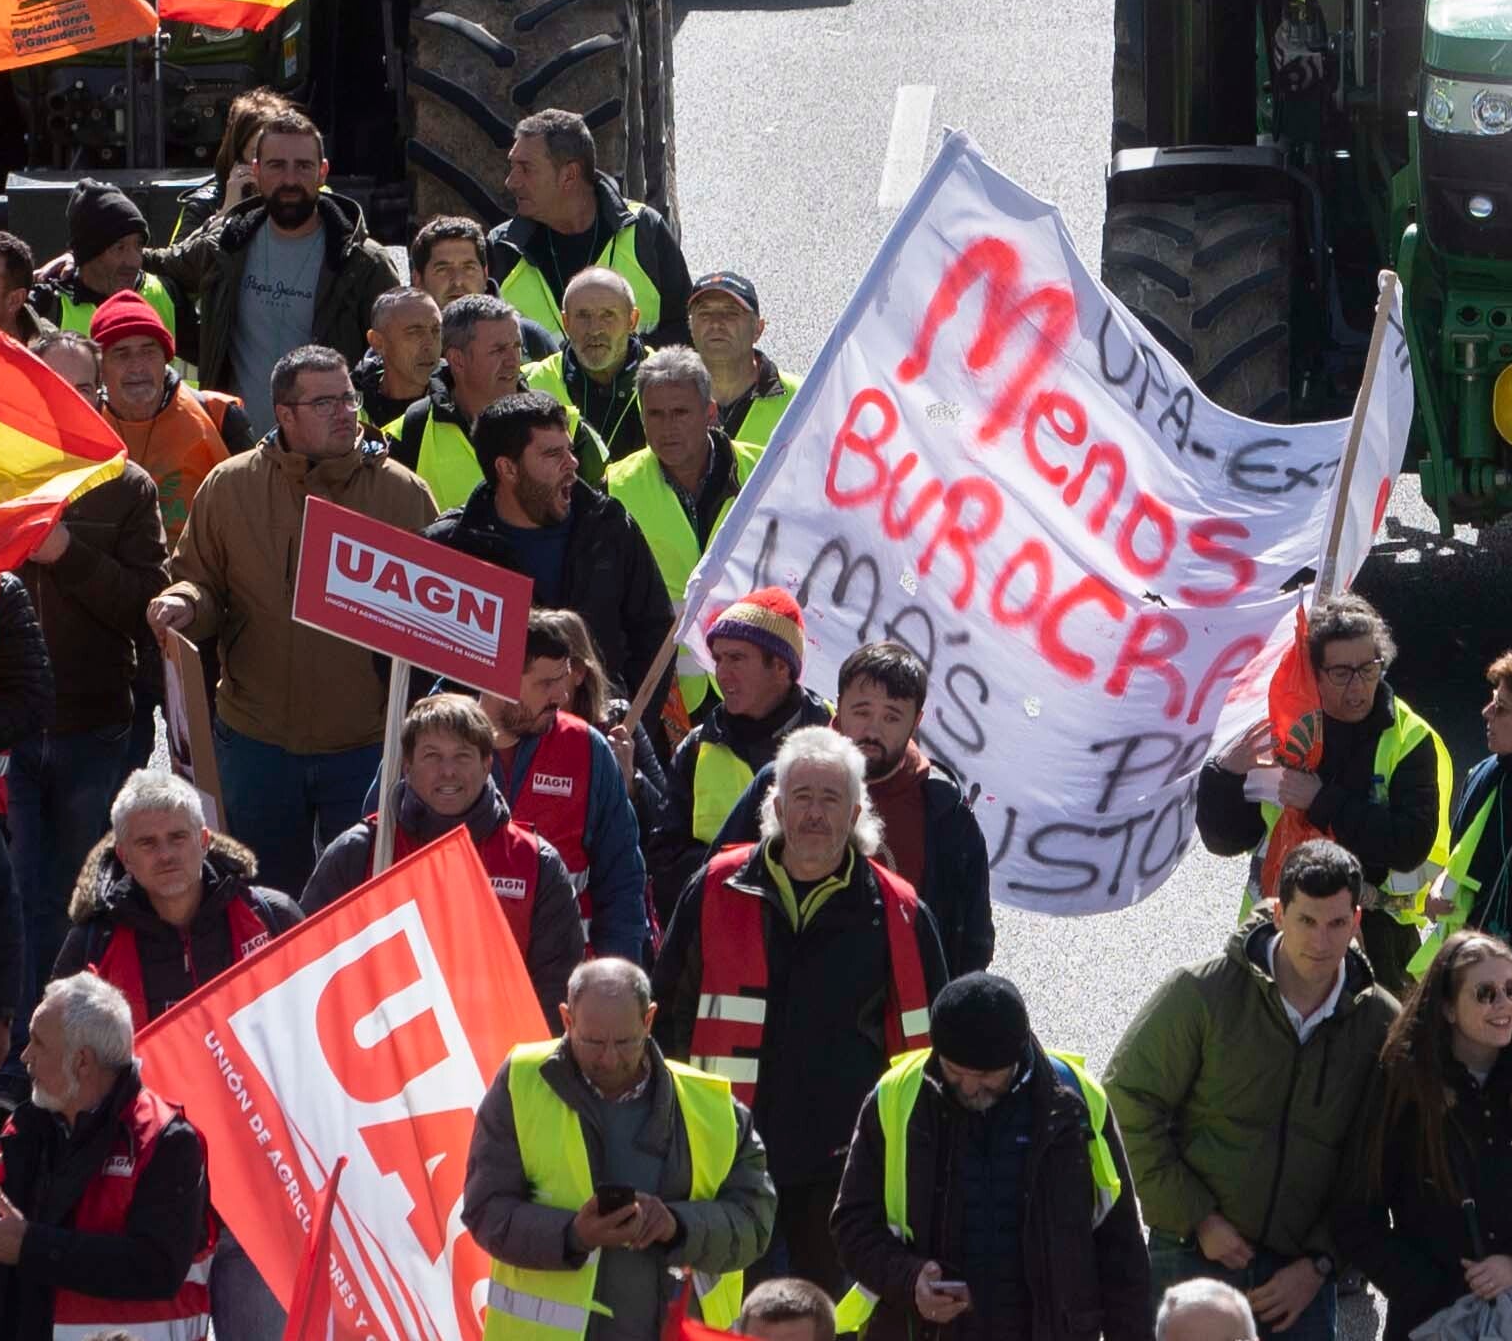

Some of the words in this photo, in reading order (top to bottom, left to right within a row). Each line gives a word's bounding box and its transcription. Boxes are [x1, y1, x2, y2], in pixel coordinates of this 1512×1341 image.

[336, 541, 496, 635] UAGN
[824, 387, 1266, 725] BUROCRA
[534, 775, 572, 789] UAGN
[203, 1030, 250, 1118] UNIÓN
[251, 1117, 271, 1148] DE
